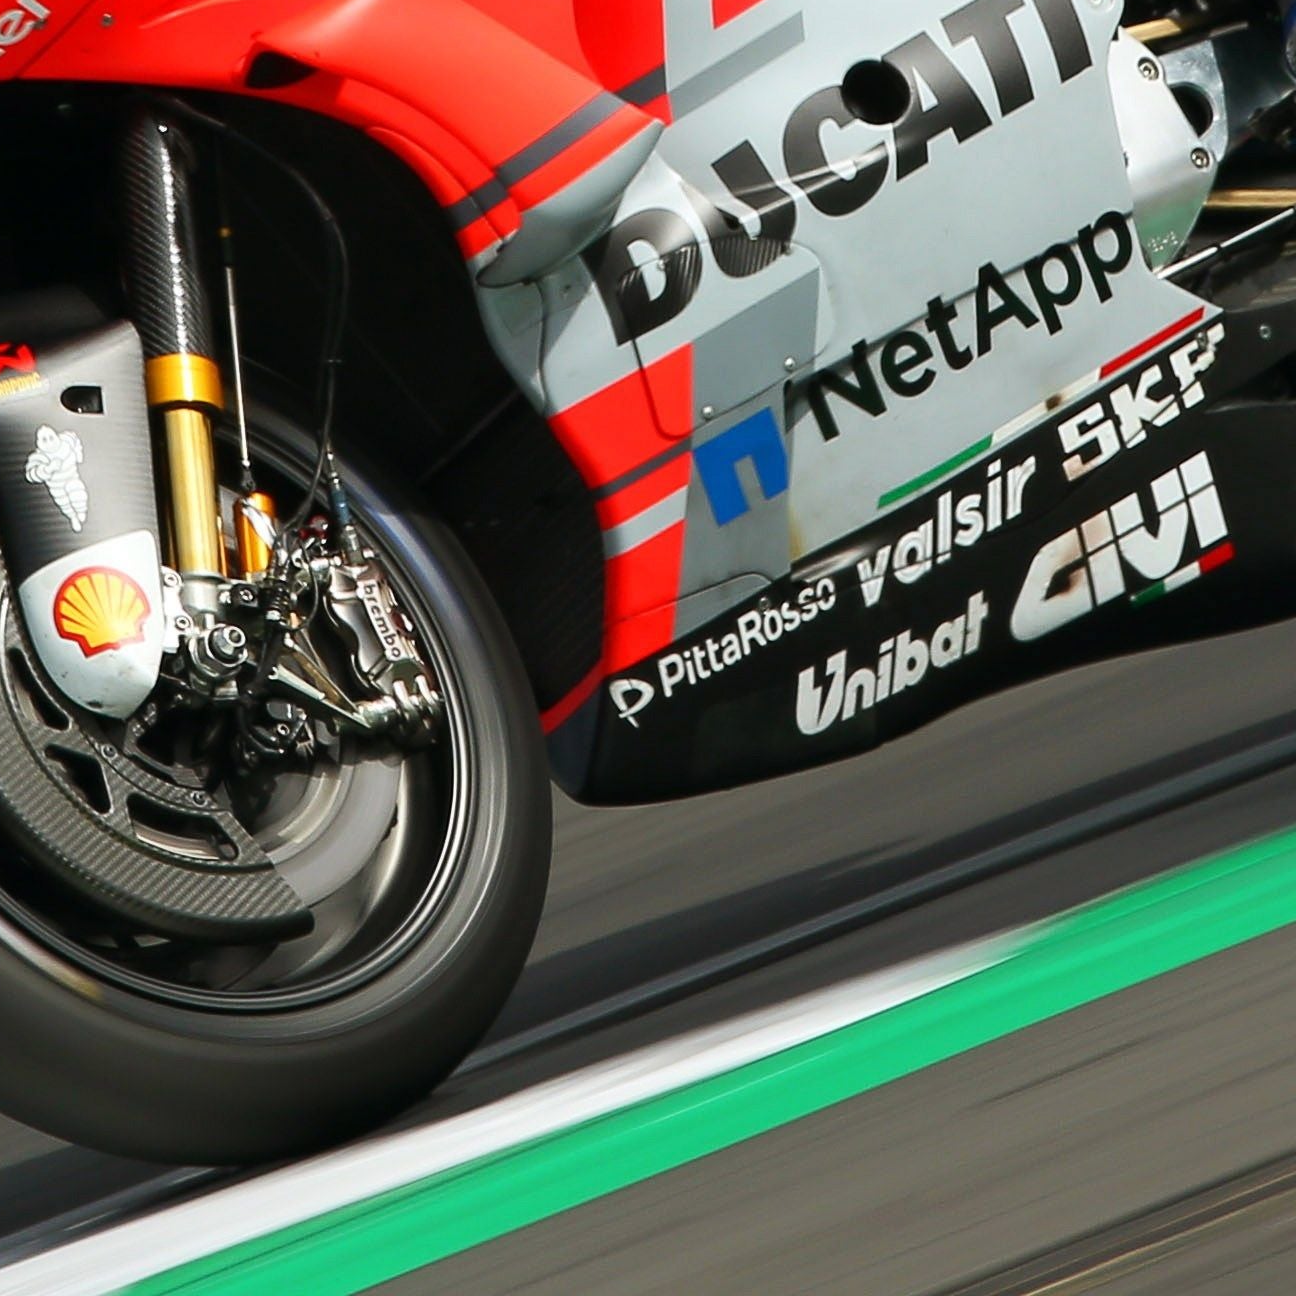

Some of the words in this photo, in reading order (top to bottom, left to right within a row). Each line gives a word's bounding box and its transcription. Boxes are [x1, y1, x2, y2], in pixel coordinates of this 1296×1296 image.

[805, 211, 1133, 442] NetApp
[1057, 323, 1226, 482] SKF
[857, 456, 1035, 606] valsir
[1011, 451, 1230, 642] GIVI
[363, 582, 402, 658] brembo
[657, 577, 837, 698] PittaRosso
[795, 592, 989, 735] Unibat
